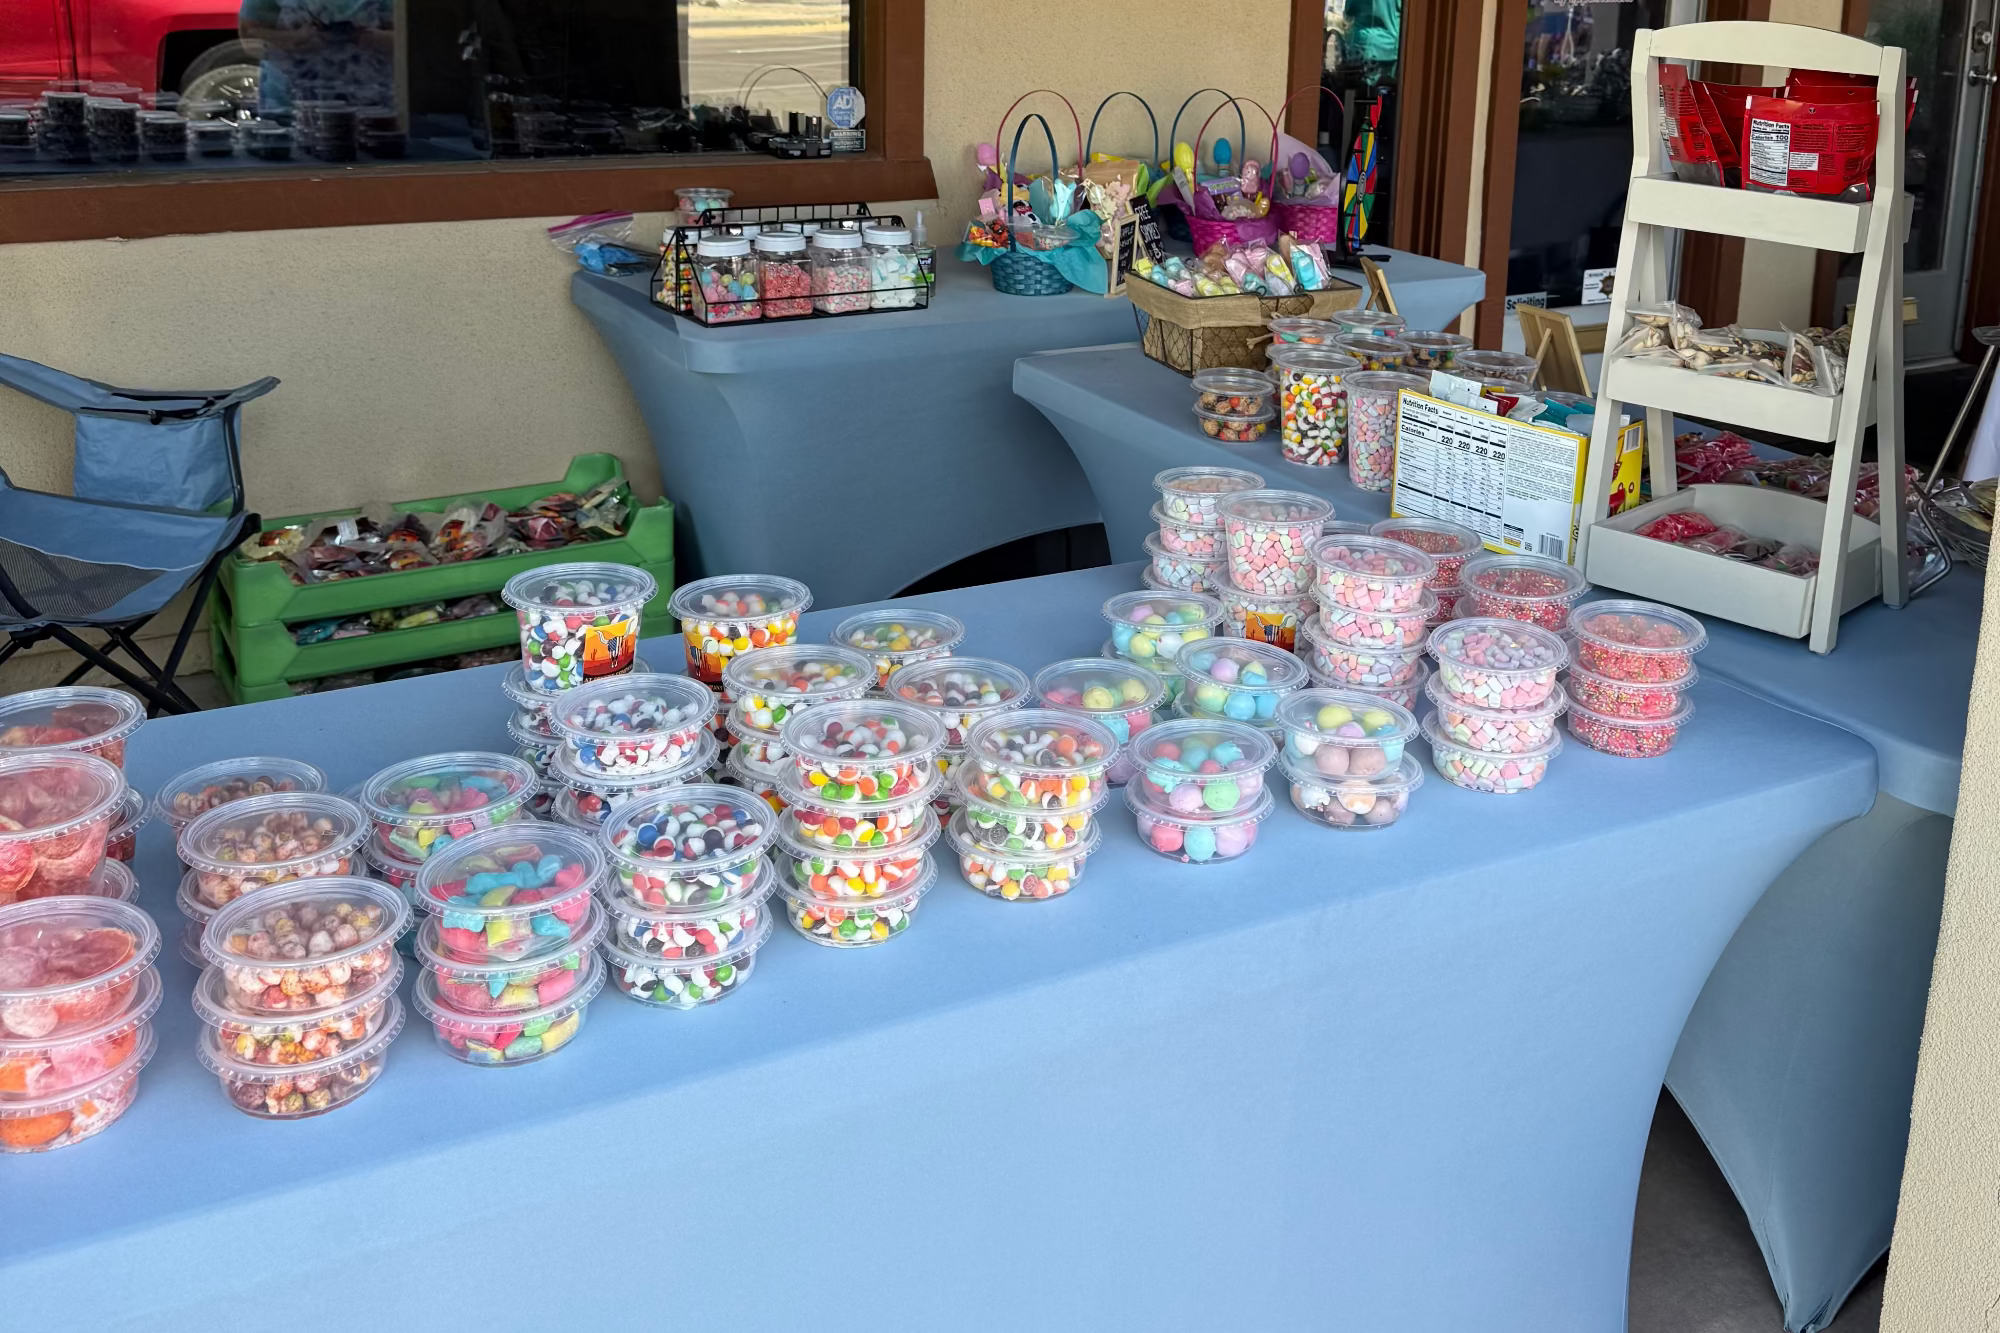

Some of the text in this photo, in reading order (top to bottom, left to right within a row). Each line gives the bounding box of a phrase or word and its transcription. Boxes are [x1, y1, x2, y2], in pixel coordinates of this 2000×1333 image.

[1403, 397, 1424, 410] Nutrition
[1424, 403, 1439, 414] Facts
[1401, 424, 1425, 436] Calories
[1441, 435, 1454, 445] 220
[1458, 440, 1471, 450] 220
[1475, 445, 1488, 455] 220
[1492, 450, 1506, 460] 220
